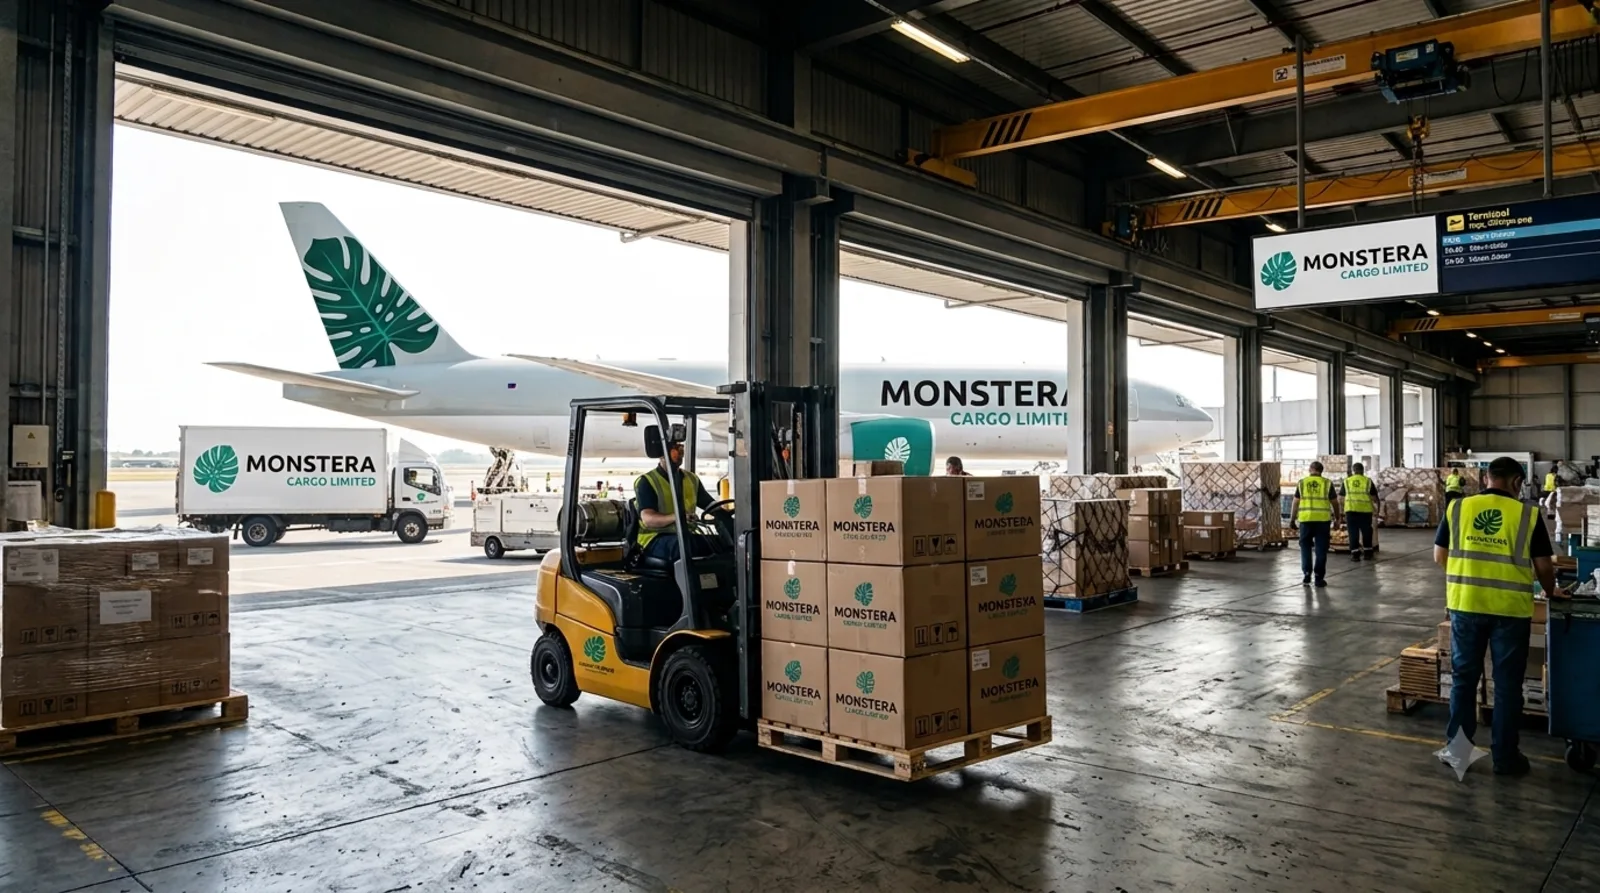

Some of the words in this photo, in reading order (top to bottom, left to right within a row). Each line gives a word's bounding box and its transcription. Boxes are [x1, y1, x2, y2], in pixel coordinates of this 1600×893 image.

[1303, 243, 1428, 272] MONSTERA
[1341, 267, 1380, 280] CARGO
[1382, 262, 1429, 276] LIMITED
[950, 412, 1011, 426] CARGO
[246, 454, 376, 473] MONSTERA
[286, 476, 328, 487] CARGO
[330, 477, 376, 487] LIMITED
[833, 521, 896, 533] MONSTERA
[765, 600, 821, 616] MONSTERA
[834, 606, 897, 623] MONSTERA
[766, 680, 822, 701] MONSTERA
[835, 692, 898, 715] MONSTERA
